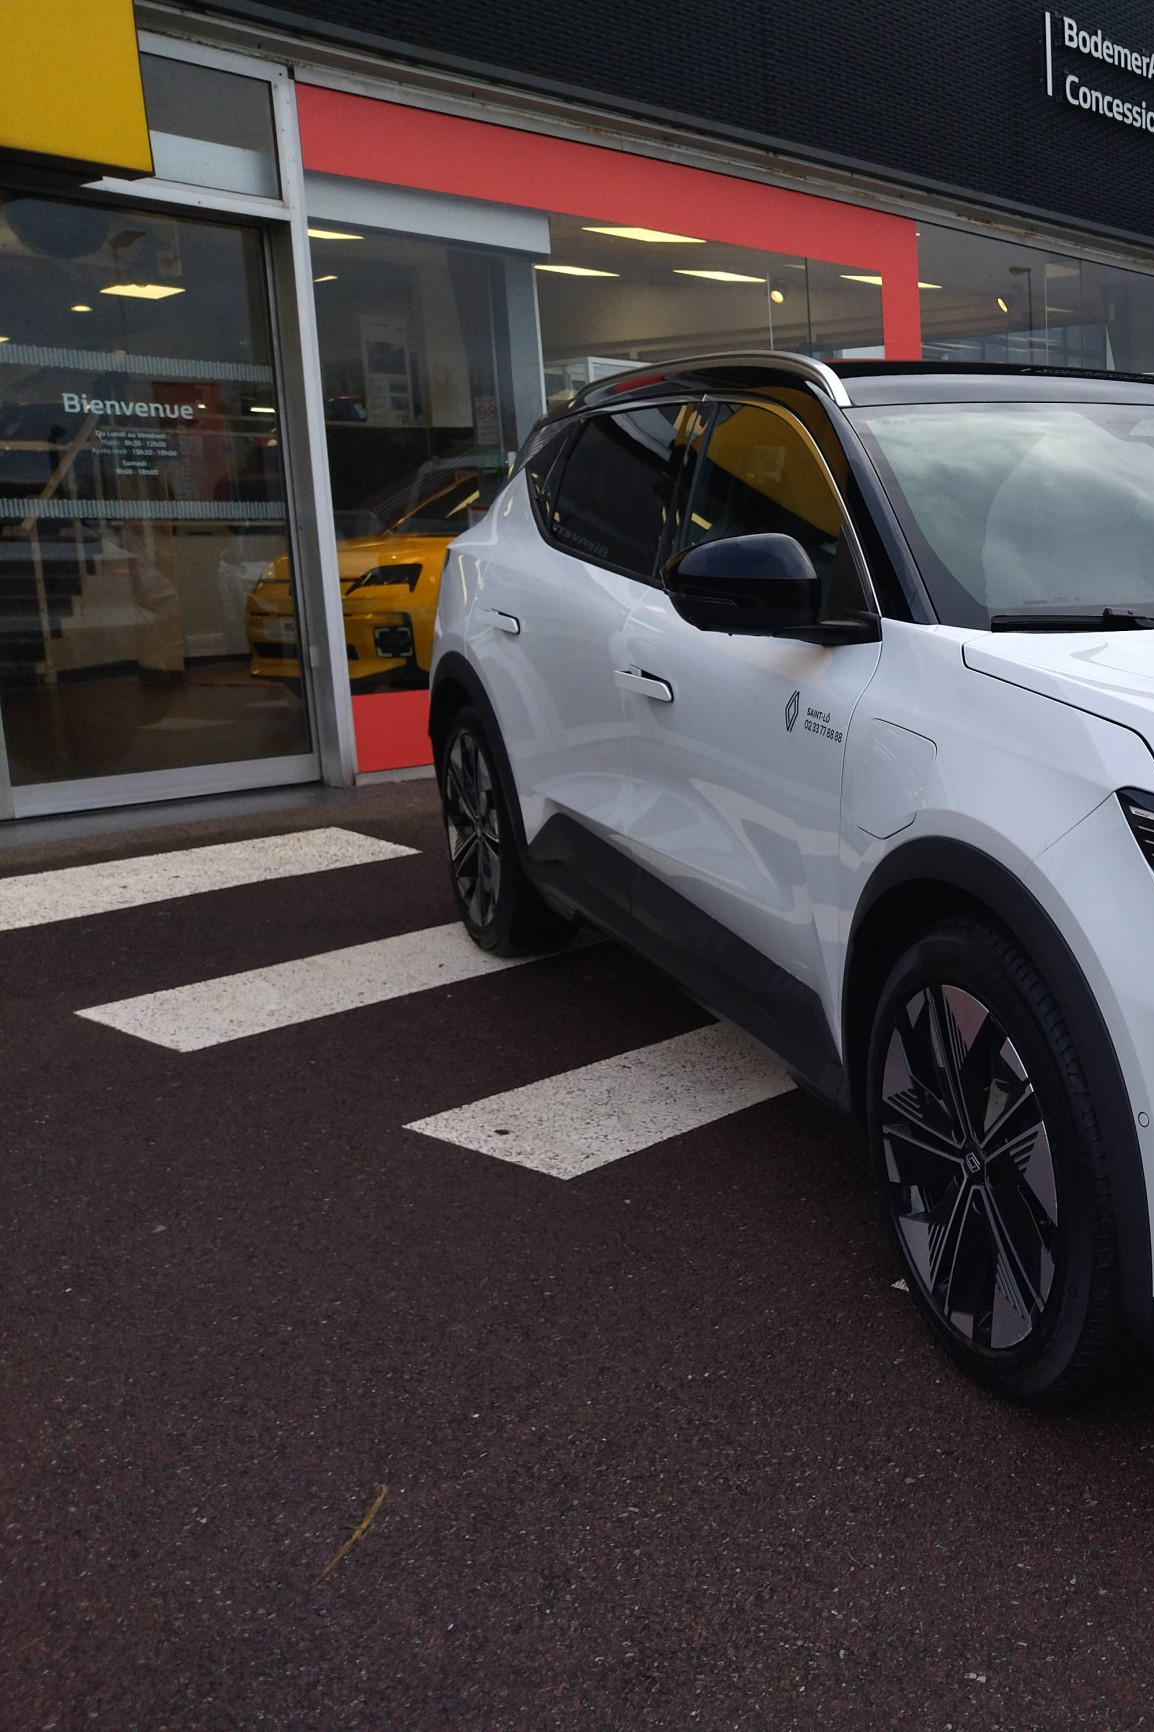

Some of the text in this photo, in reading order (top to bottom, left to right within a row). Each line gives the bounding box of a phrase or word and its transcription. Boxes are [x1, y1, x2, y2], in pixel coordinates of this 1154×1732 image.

[62, 392, 194, 420] Bienvenue
[804, 719, 812, 731] 02
[819, 724, 827, 737] 77
